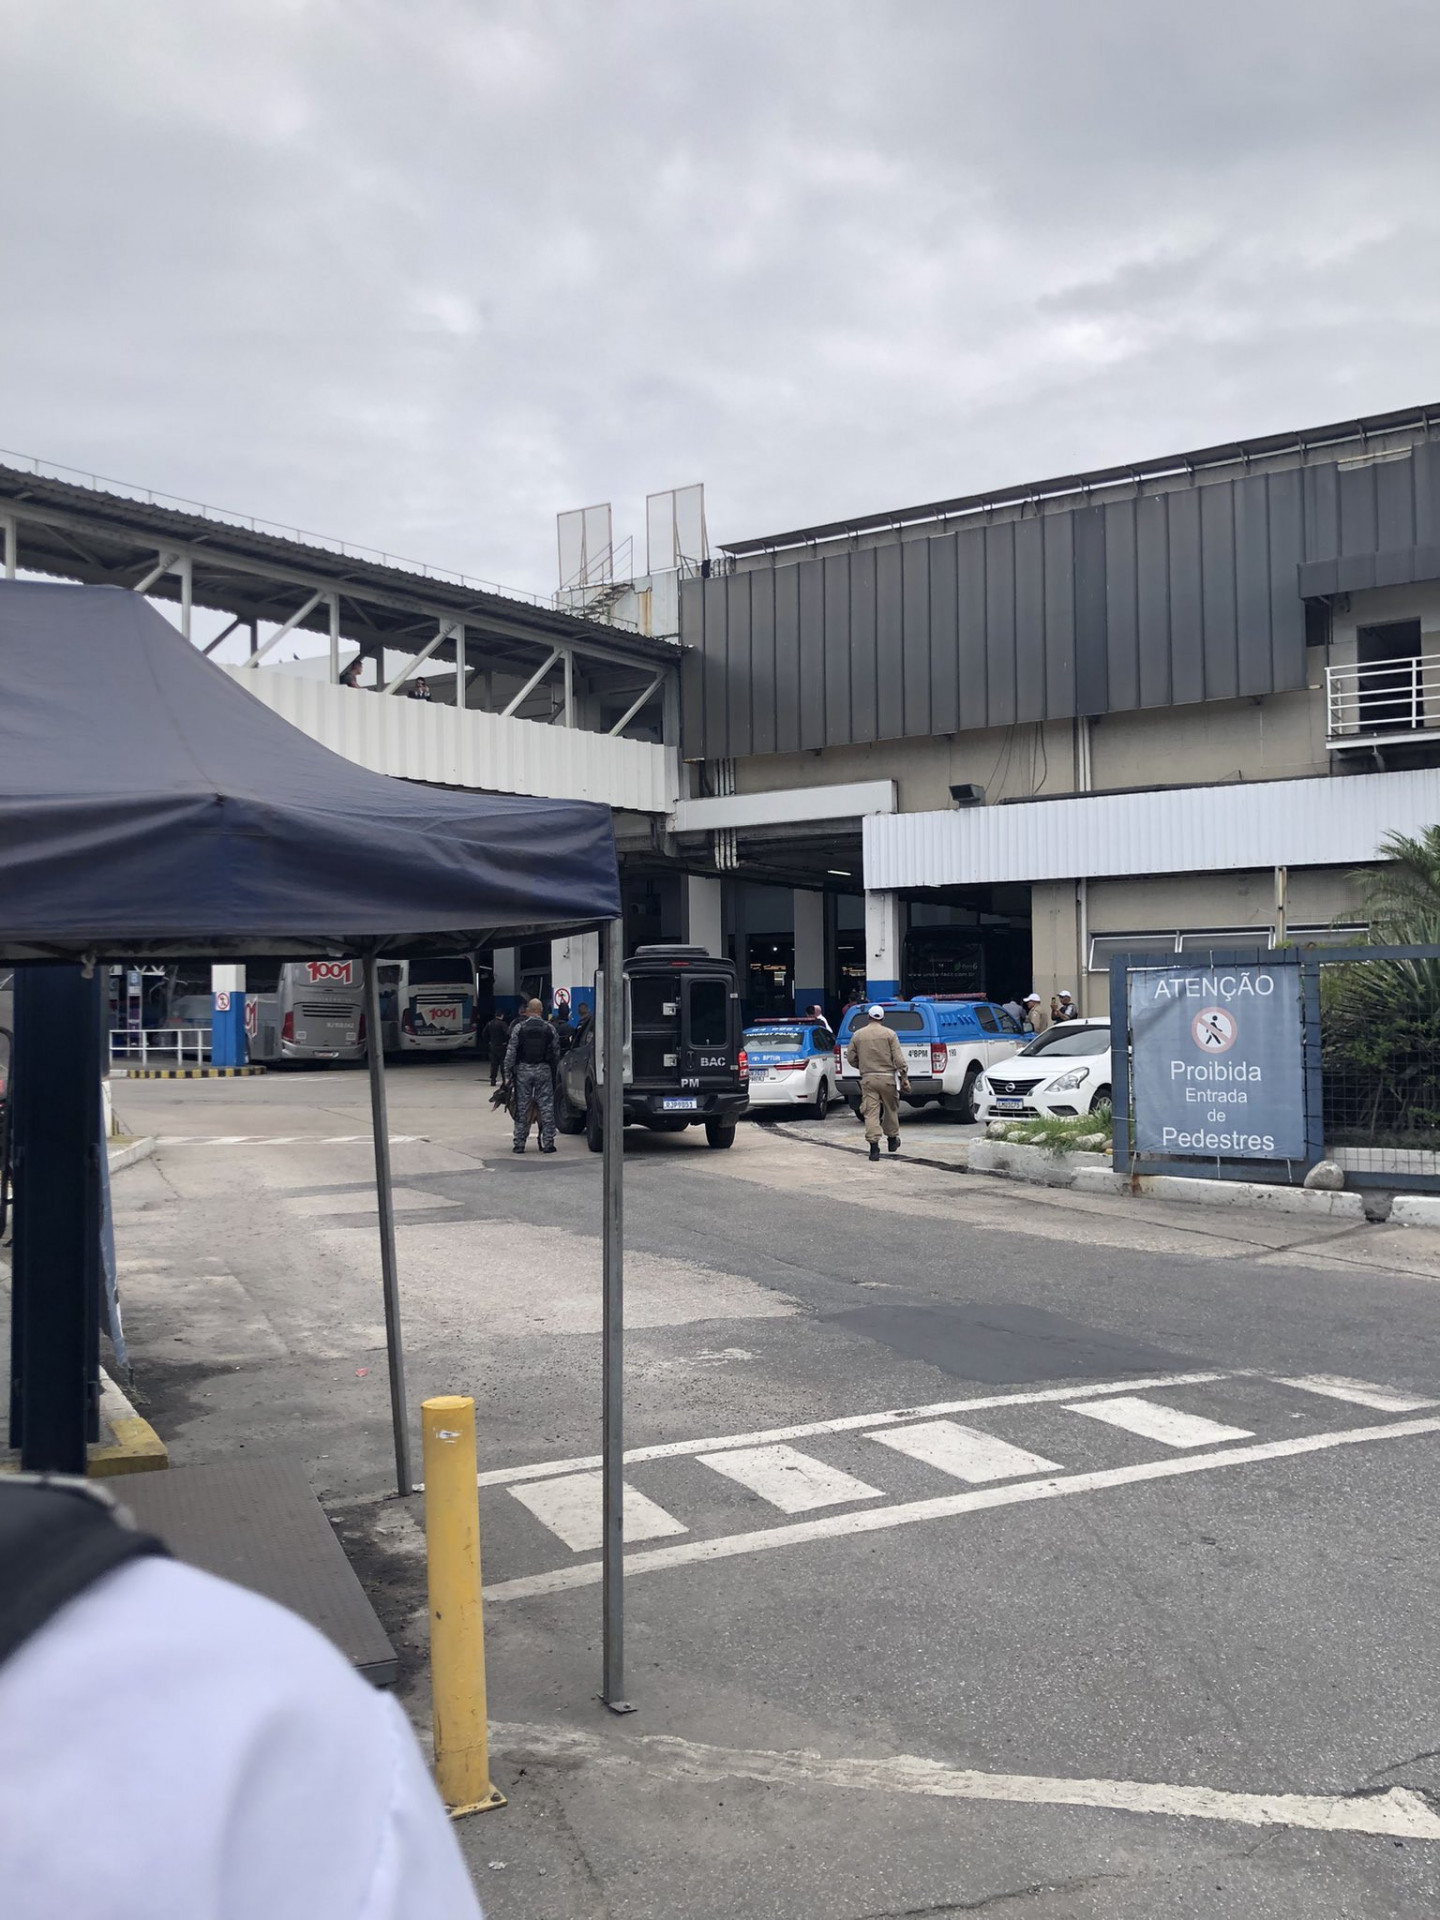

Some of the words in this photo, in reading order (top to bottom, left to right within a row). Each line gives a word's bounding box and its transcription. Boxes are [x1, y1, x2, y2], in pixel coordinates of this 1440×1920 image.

[305, 960, 352, 984] 1001
[1154, 972, 1274, 1002] ATENÇÃO
[429, 1007, 456, 1020] 1001
[700, 1057, 726, 1066] BAC
[1170, 1060, 1262, 1081] Proibida
[681, 1078, 700, 1088] PM
[1185, 1088, 1248, 1103] Entrada
[1207, 1109, 1226, 1122] de
[1162, 1127, 1275, 1151] Pedestres
